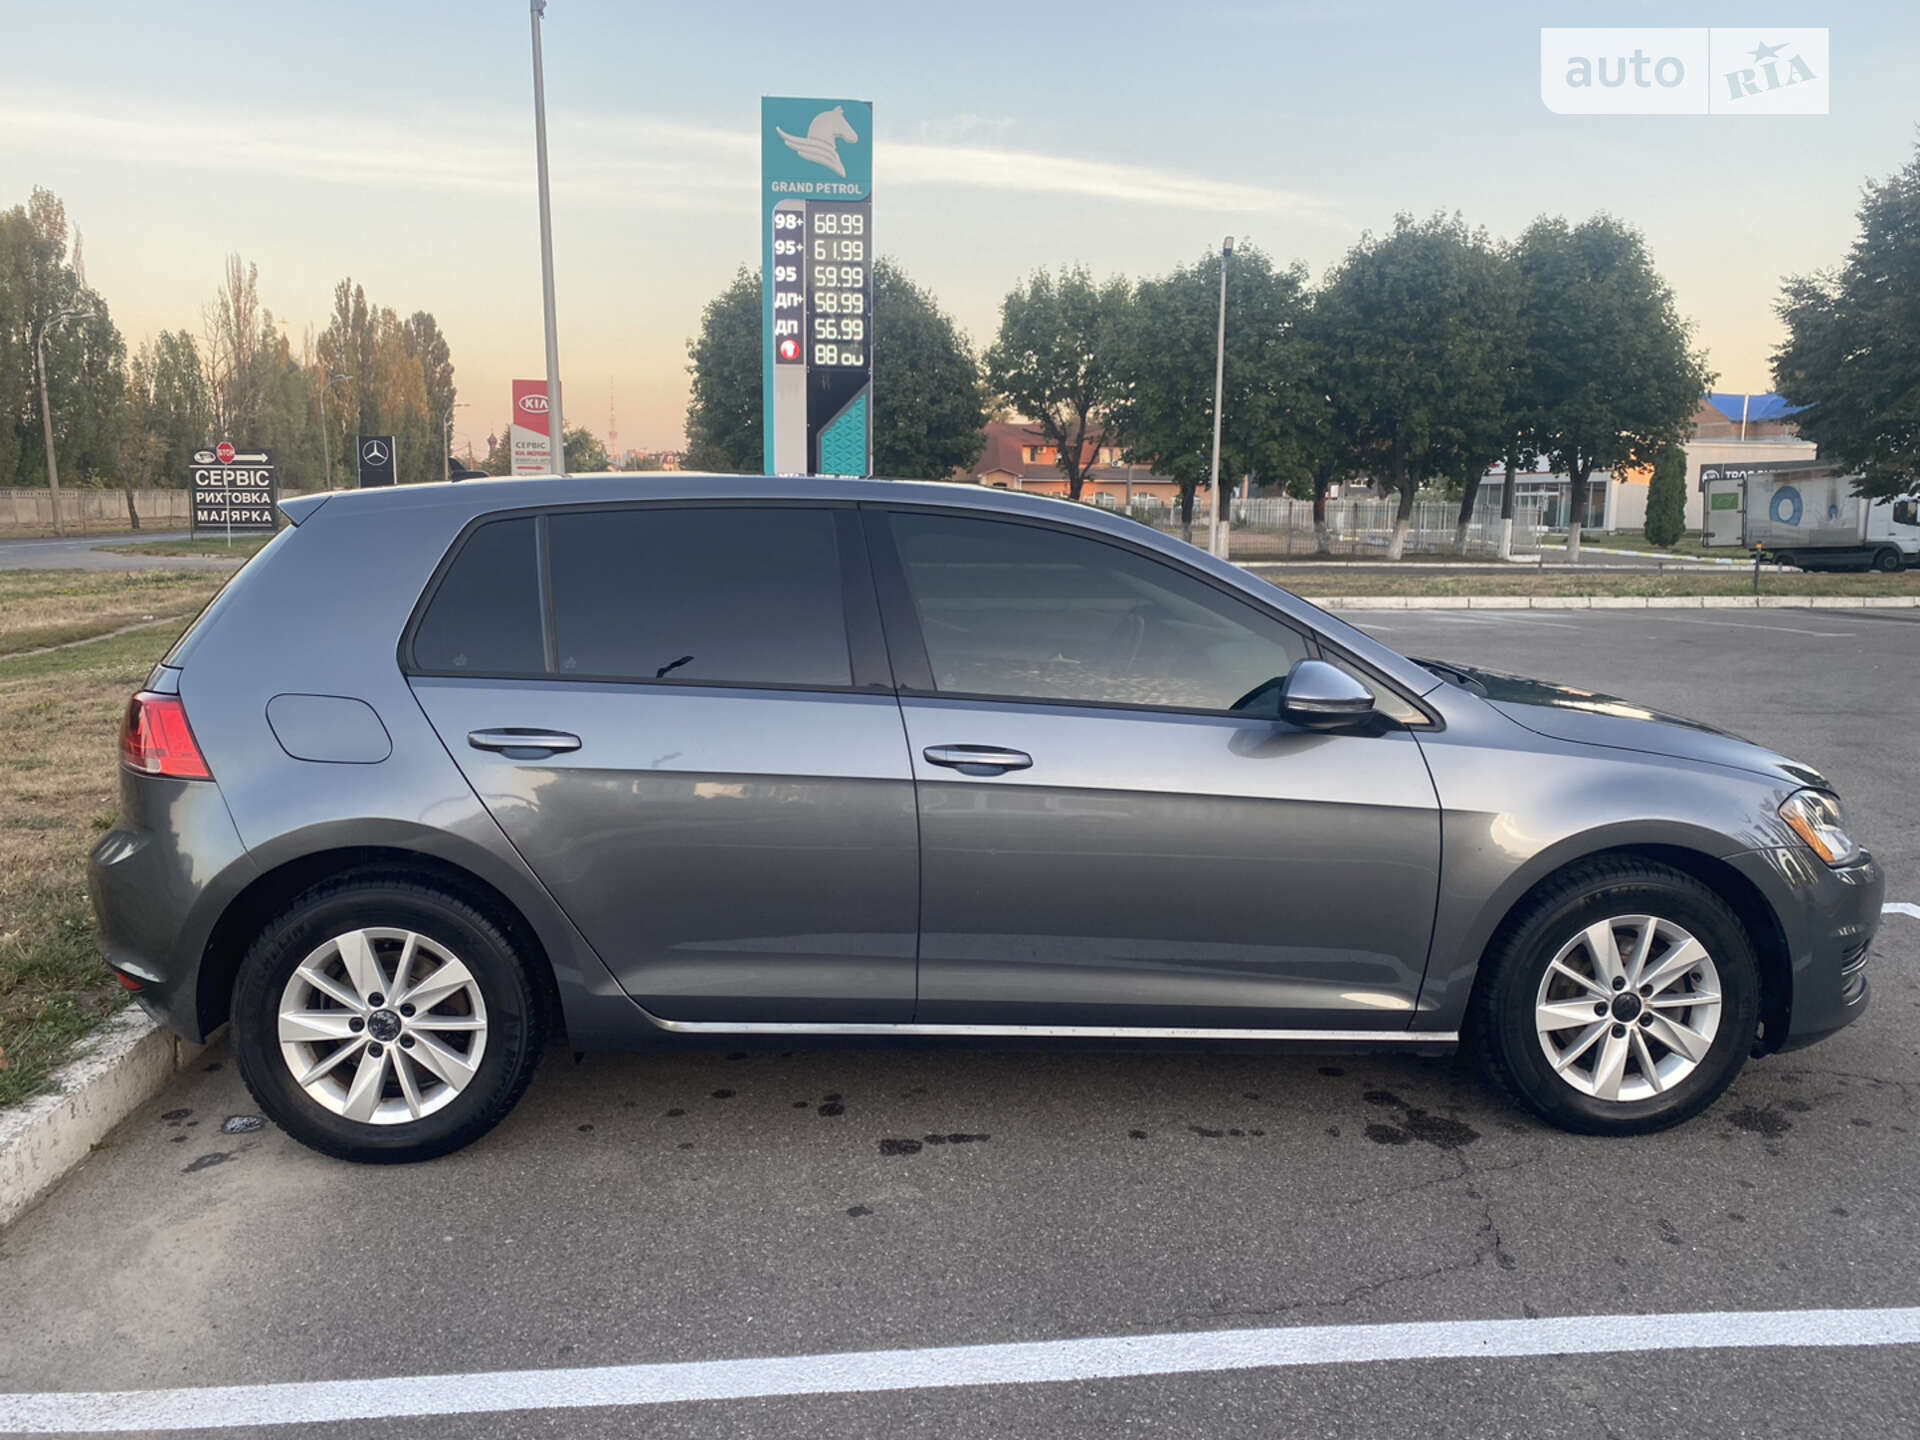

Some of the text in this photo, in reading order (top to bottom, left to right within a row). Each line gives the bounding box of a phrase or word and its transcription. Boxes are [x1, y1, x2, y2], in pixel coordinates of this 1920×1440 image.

[771, 181, 862, 194] GRAND PETROL
[774, 213, 864, 236] 98+ 68.99
[774, 239, 864, 262] 95+ 61.99
[774, 266, 864, 288] 95 59.99
[774, 292, 864, 314] ДП+ 58.99
[774, 318, 864, 341] ДП 56.99
[525, 398, 549, 409] KIA
[195, 469, 270, 487] СЕРВІС
[196, 491, 271, 505] РИХТОВКА
[197, 510, 273, 522] МАЛЯРКА
